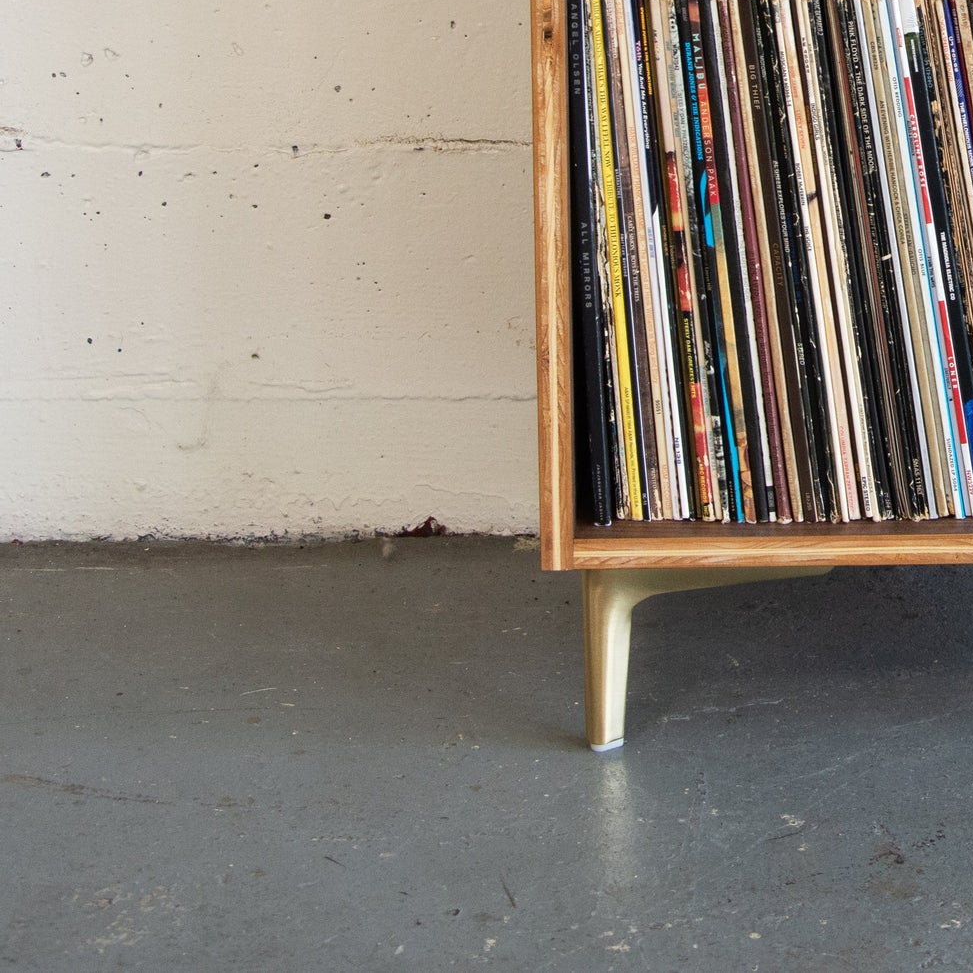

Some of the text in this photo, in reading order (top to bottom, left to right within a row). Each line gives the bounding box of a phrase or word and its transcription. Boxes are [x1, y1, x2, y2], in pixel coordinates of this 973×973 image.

[570, 4, 578, 46] ANGEL
[692, 33, 705, 89] MALIBU
[640, 90, 646, 100] Me
[685, 42, 694, 70] DURAND
[693, 117, 703, 160] INDICATIONS
[751, 84, 760, 110] THIEF
[850, 39, 859, 62] FLOYD
[857, 87, 865, 106] DARK
[862, 124, 869, 135] OF
[866, 151, 874, 172] MOON
[879, 101, 886, 109] AN
[894, 92, 903, 117] REDDING
[642, 115, 651, 149] Everything
[700, 101, 713, 162] ANDERSON
[881, 110, 889, 134] EVENING
[961, 114, 971, 149] THELONIOUS
[887, 151, 895, 171] HERBIE
[910, 114, 926, 188] CAROLINE ROSE
[890, 172, 899, 200] HANCOCK
[777, 190, 786, 220] EXPLORES
[773, 243, 783, 286] CAPACITY
[941, 242, 950, 268] MAGNOLIA
[582, 252, 592, 308] MIRRORS
[945, 269, 954, 292] ELECTRIC
[947, 356, 958, 389] LONER
